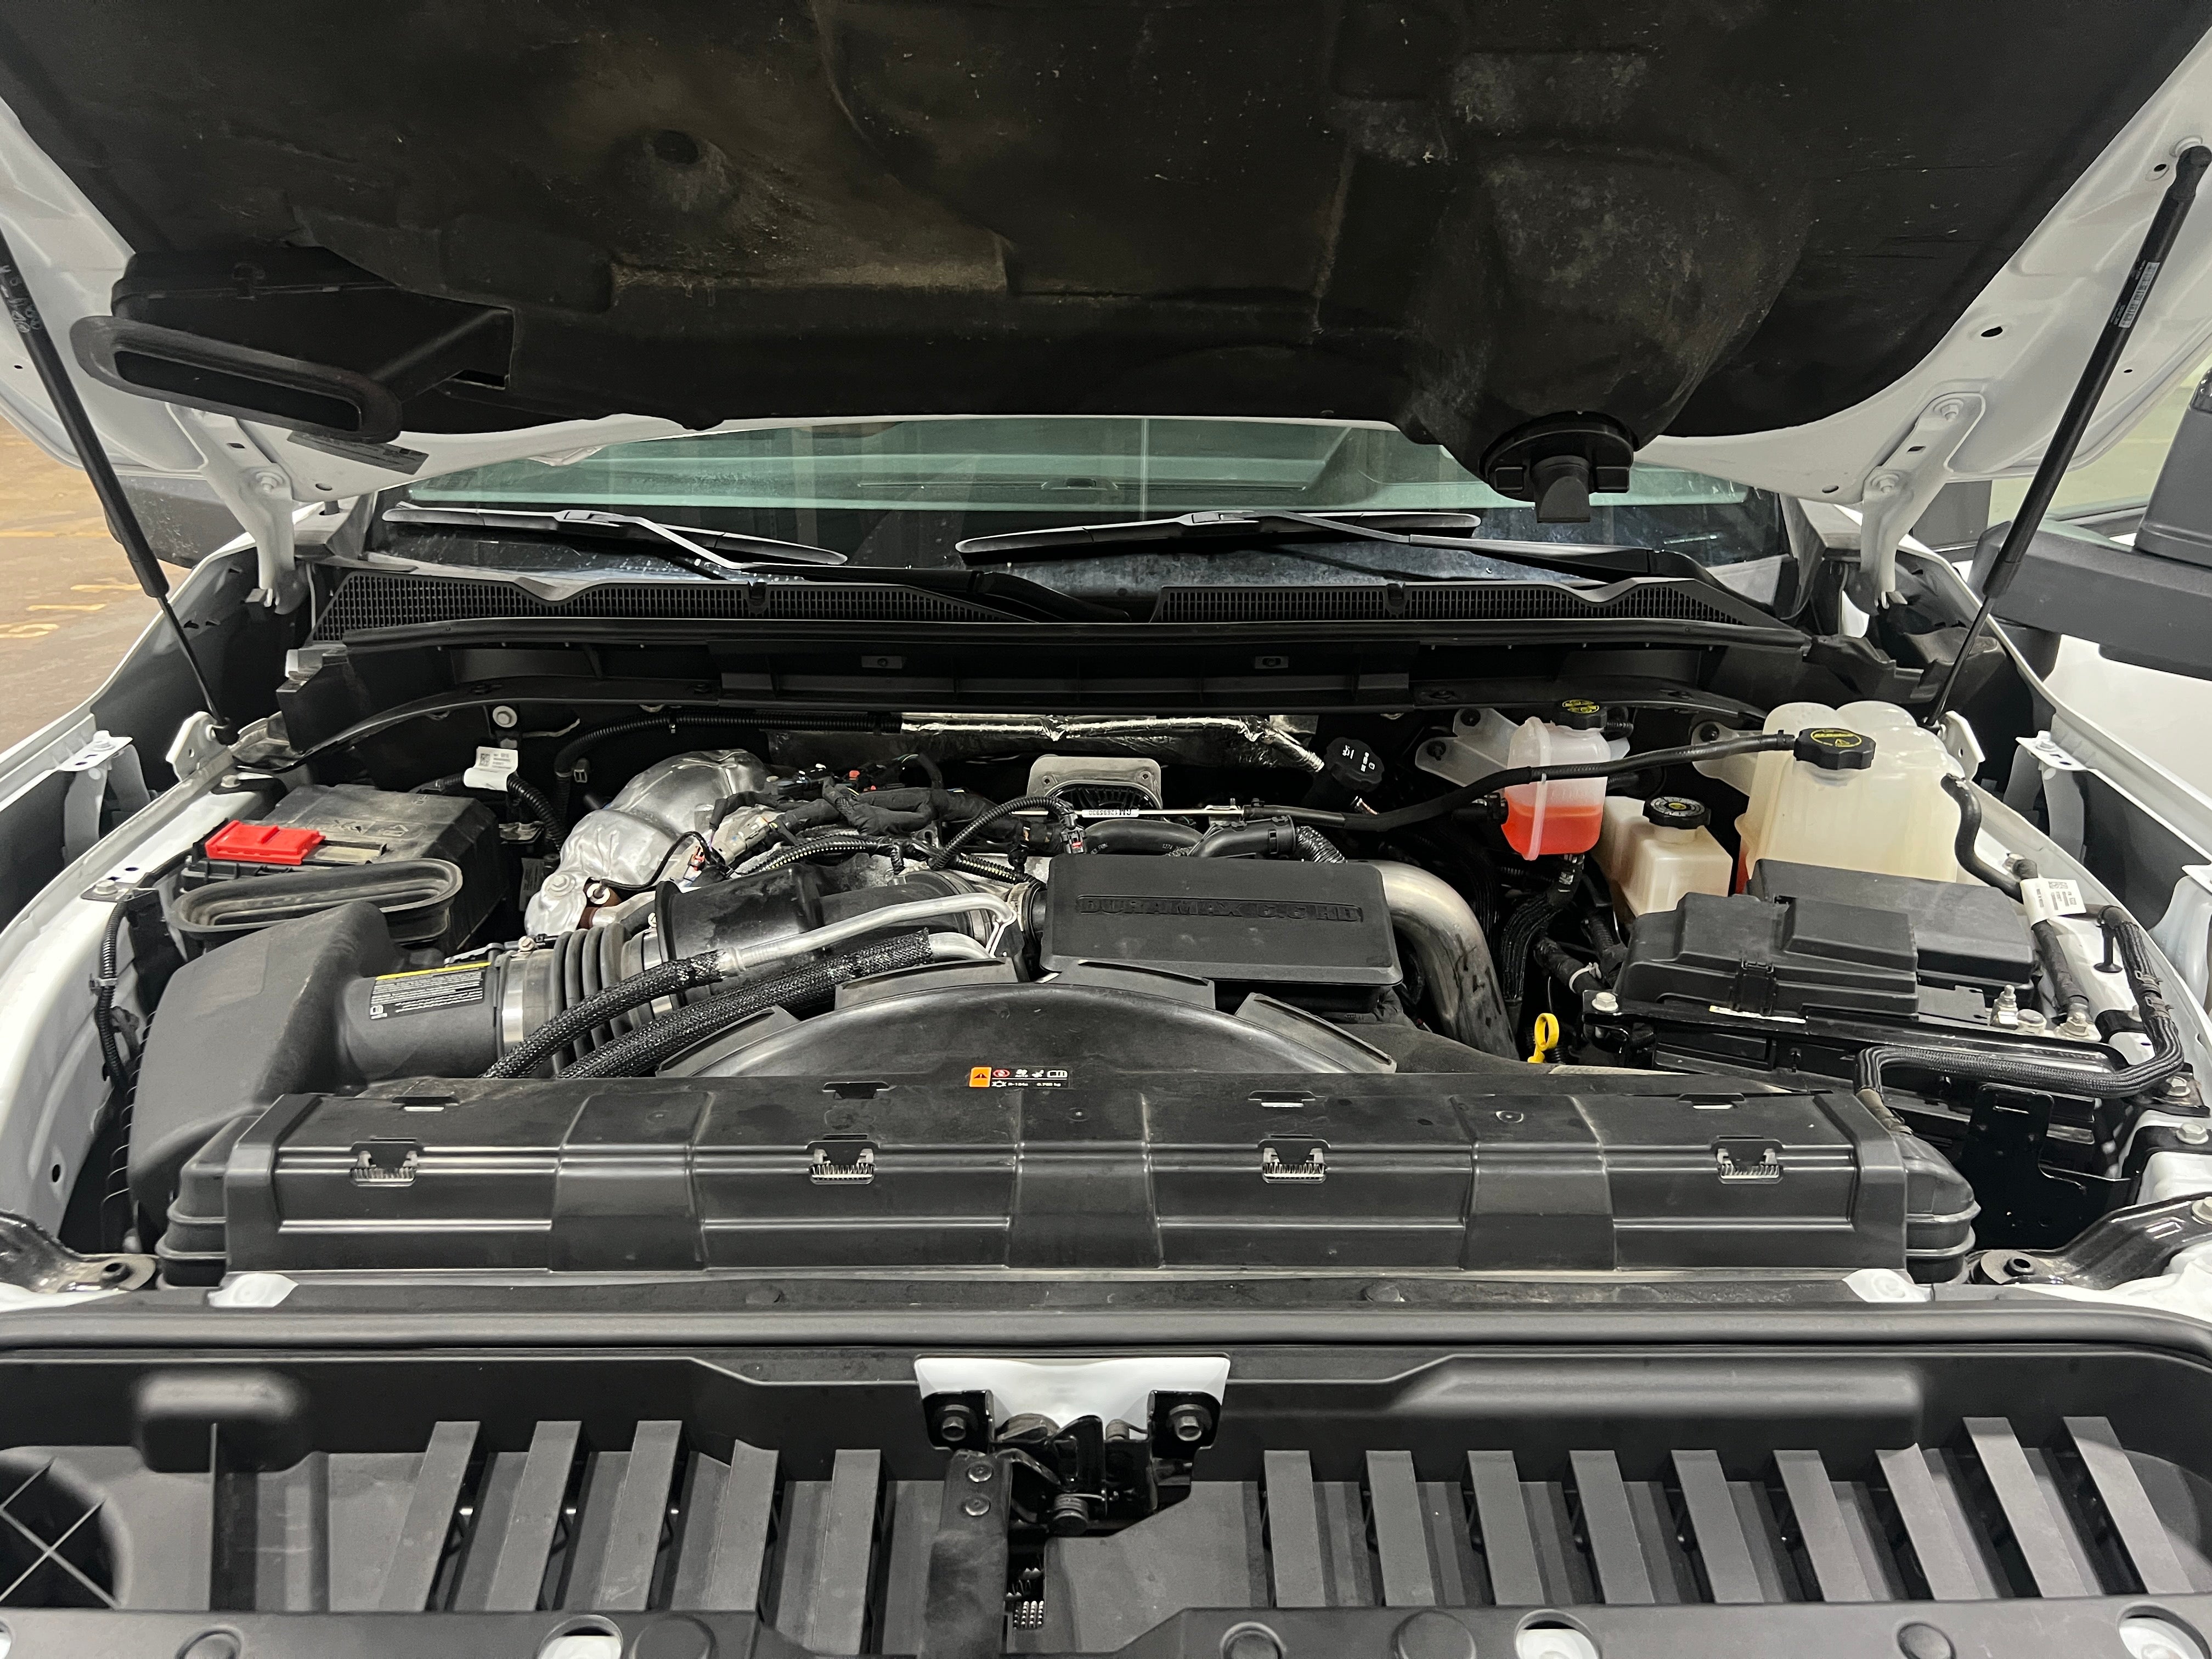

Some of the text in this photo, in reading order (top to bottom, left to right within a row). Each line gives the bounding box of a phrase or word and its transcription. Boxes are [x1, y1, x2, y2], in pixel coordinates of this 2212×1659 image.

[1080, 898, 1361, 922] DURAMAX 6.6 HD
